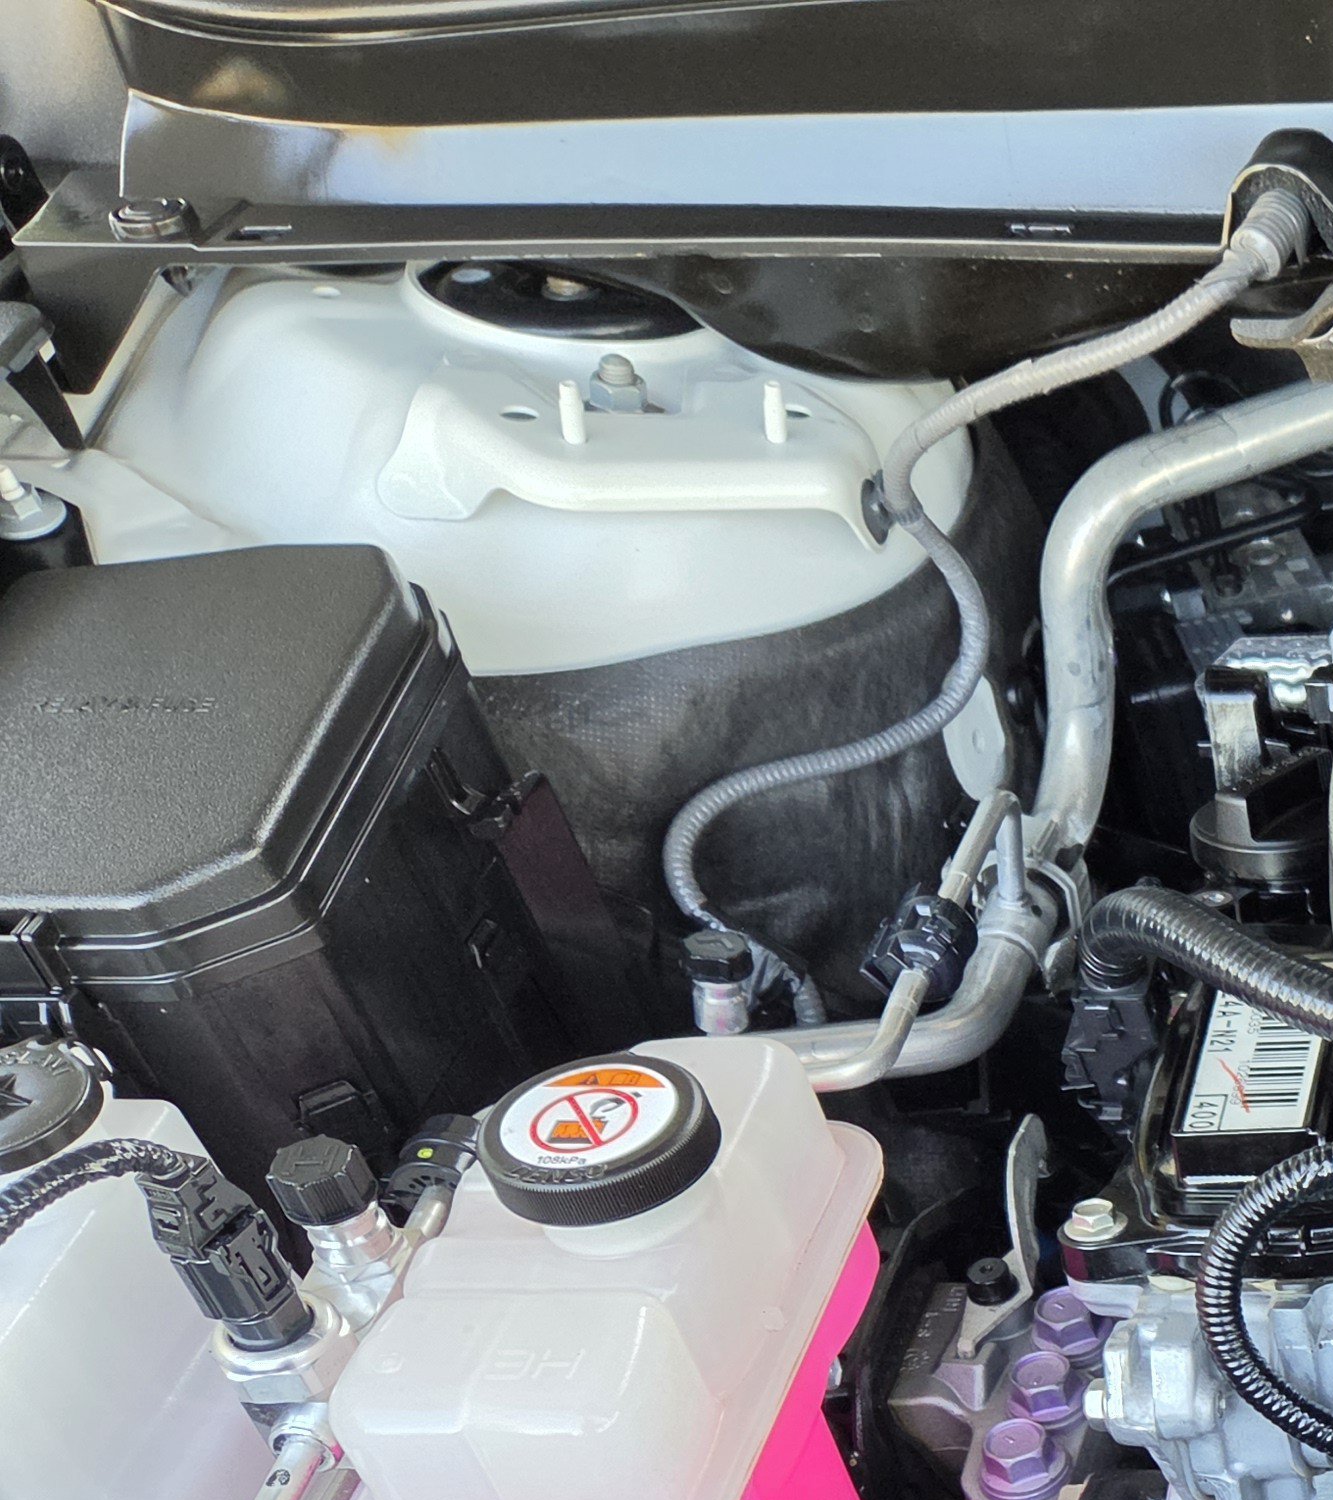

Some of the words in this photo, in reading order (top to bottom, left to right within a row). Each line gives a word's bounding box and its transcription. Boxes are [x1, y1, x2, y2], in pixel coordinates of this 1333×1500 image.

[1206, 993, 1246, 1053] 4A-N21
[1188, 1101, 1219, 1130] 400
[536, 1153, 588, 1166] 108kPa
